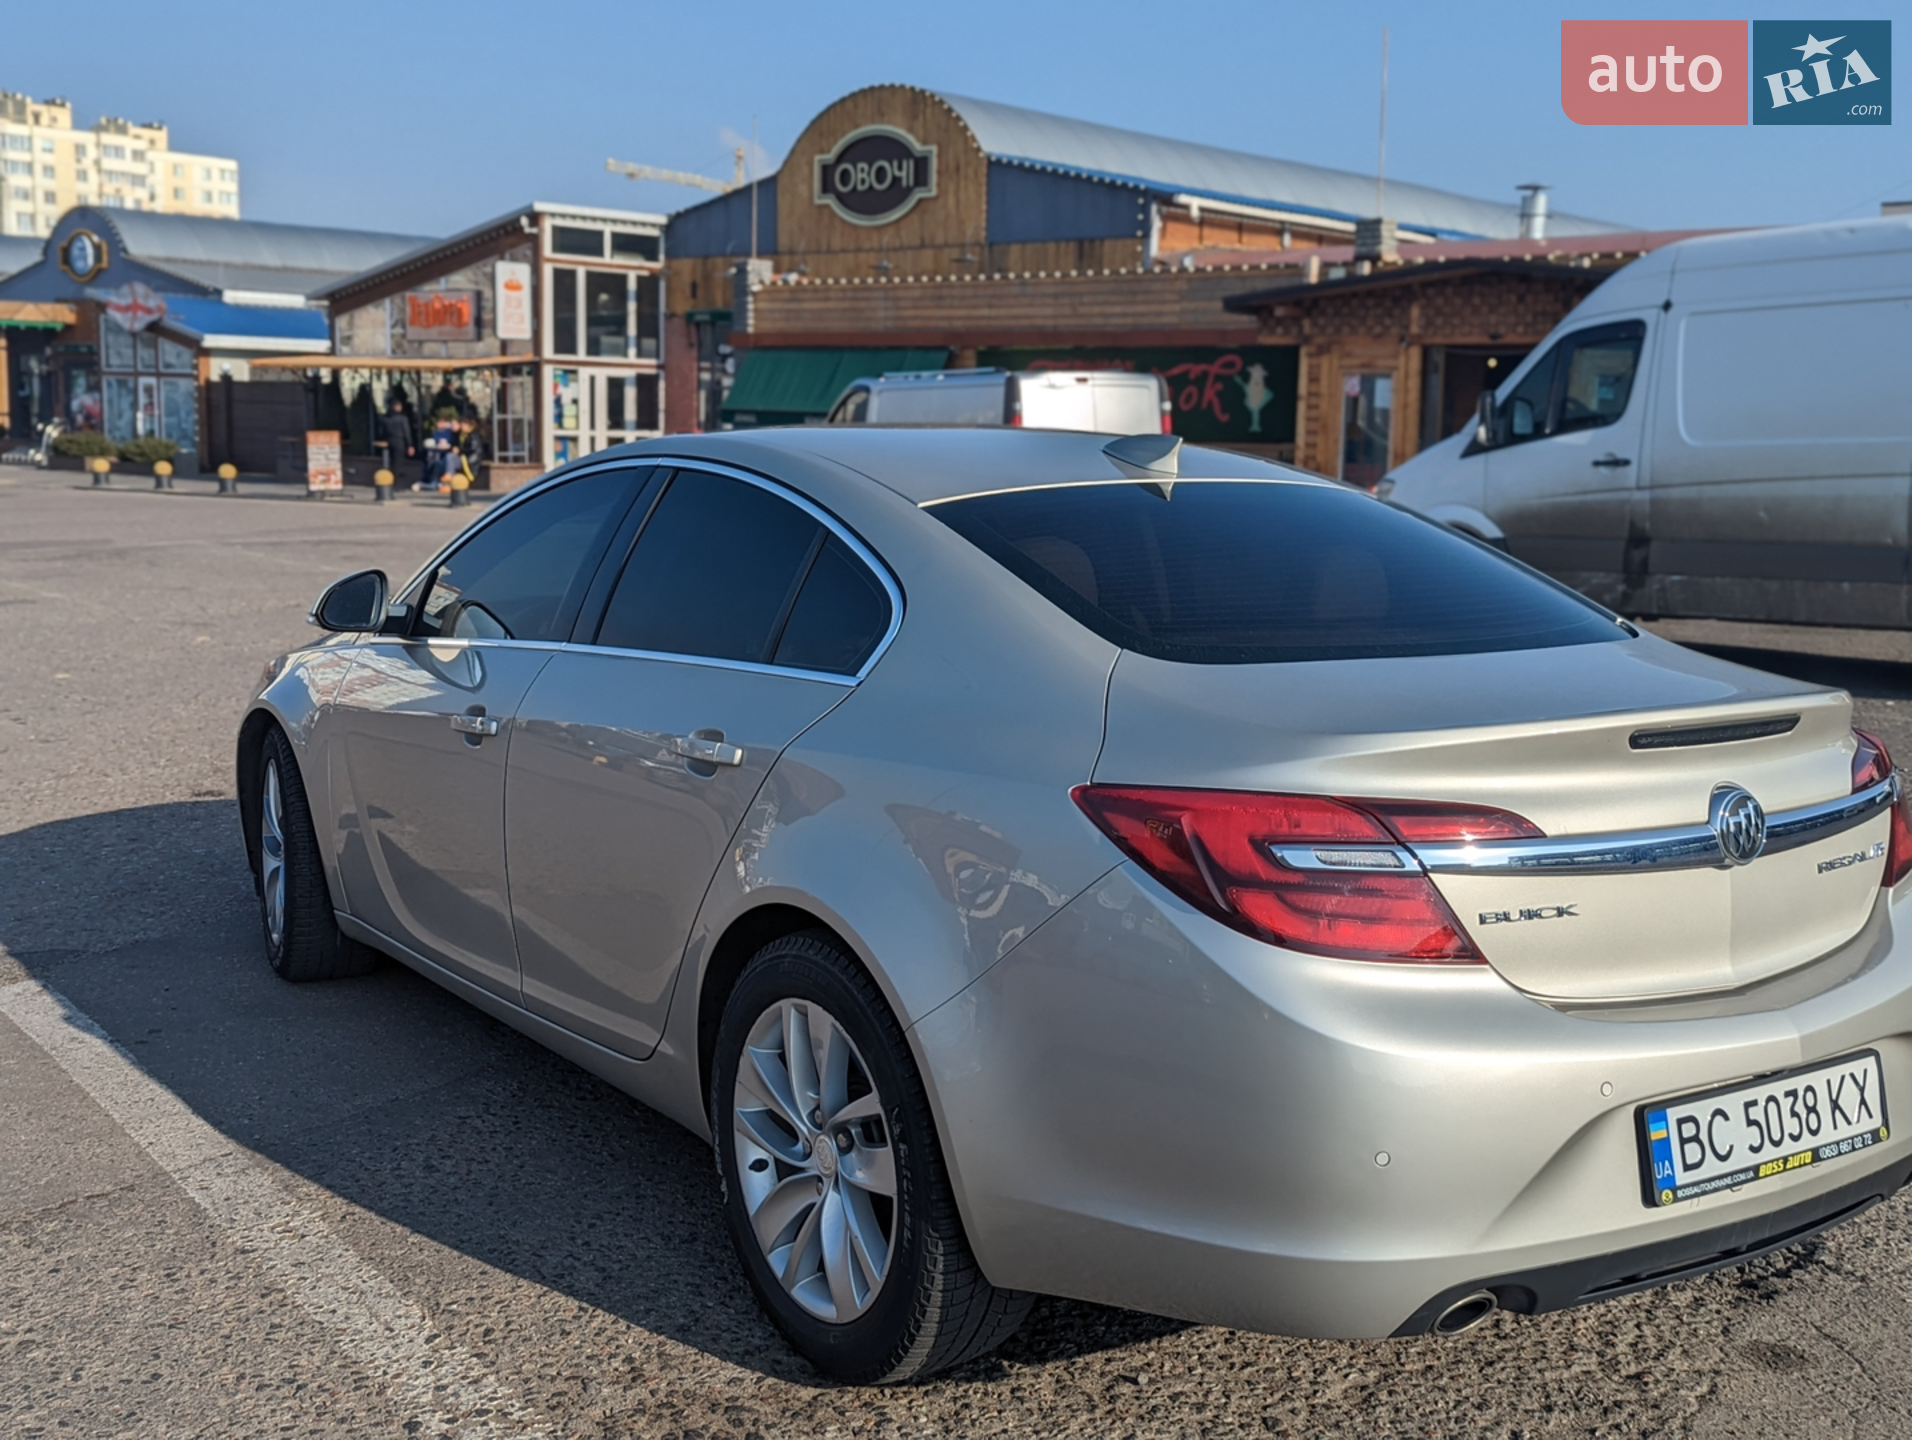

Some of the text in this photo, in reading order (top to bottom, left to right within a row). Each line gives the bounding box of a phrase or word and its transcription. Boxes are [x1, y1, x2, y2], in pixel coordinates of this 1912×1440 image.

[834, 158, 914, 193] ОВОЧІ
[1479, 903, 1580, 925] BUICK
[1675, 1068, 1874, 1173] BC 5038 KX
[1654, 1160, 1673, 1179] UA
[1758, 1159, 1784, 1177] BOSS
[1785, 1150, 1812, 1169] AUTO
[1819, 1144, 1839, 1159] (063)
[1853, 1135, 1863, 1149] 02
[1863, 1132, 1873, 1145] 72
